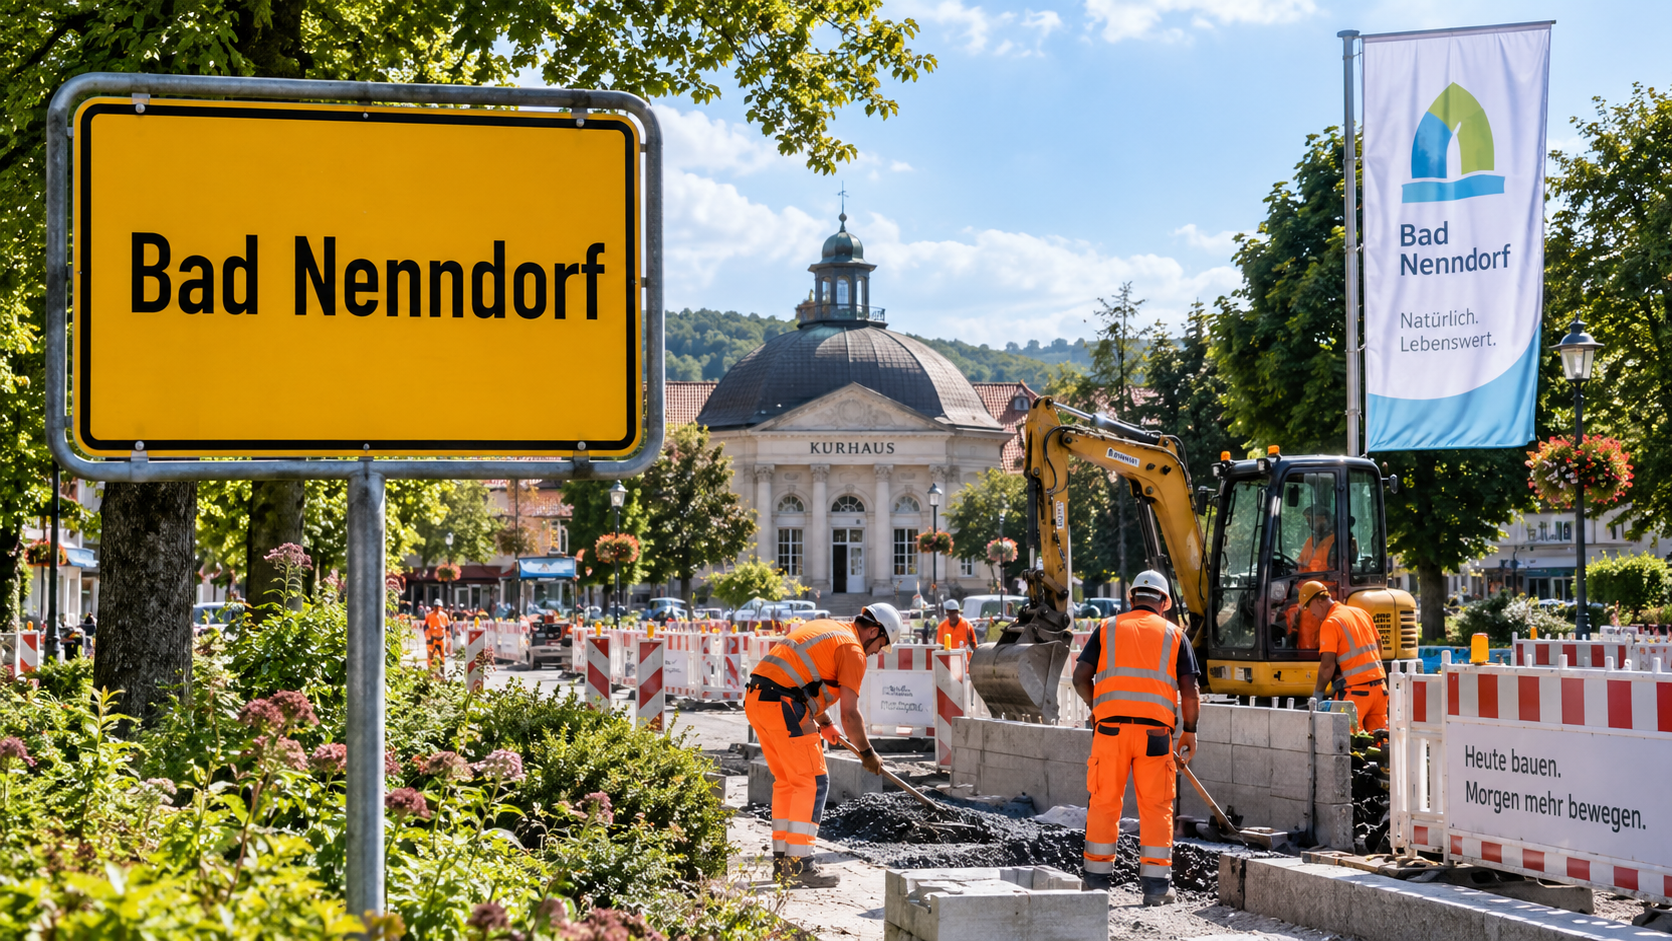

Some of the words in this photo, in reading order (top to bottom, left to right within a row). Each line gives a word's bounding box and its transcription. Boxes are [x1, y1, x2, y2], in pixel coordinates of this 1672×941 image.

[1400, 221, 1448, 247] Bad
[1400, 244, 1511, 276] Nenndorf
[131, 232, 258, 315] Bad
[295, 236, 605, 320] Nenndorf
[1400, 308, 1479, 329] Natürlich.
[1400, 331, 1497, 353] Lebenswert.
[810, 442, 895, 454] KURHAUS
[1465, 745, 1507, 771] Heute
[1511, 748, 1562, 778] bauen.
[1465, 780, 1521, 814] Morgen
[1525, 789, 1564, 816] mehr
[1568, 793, 1647, 833] bewegen.
